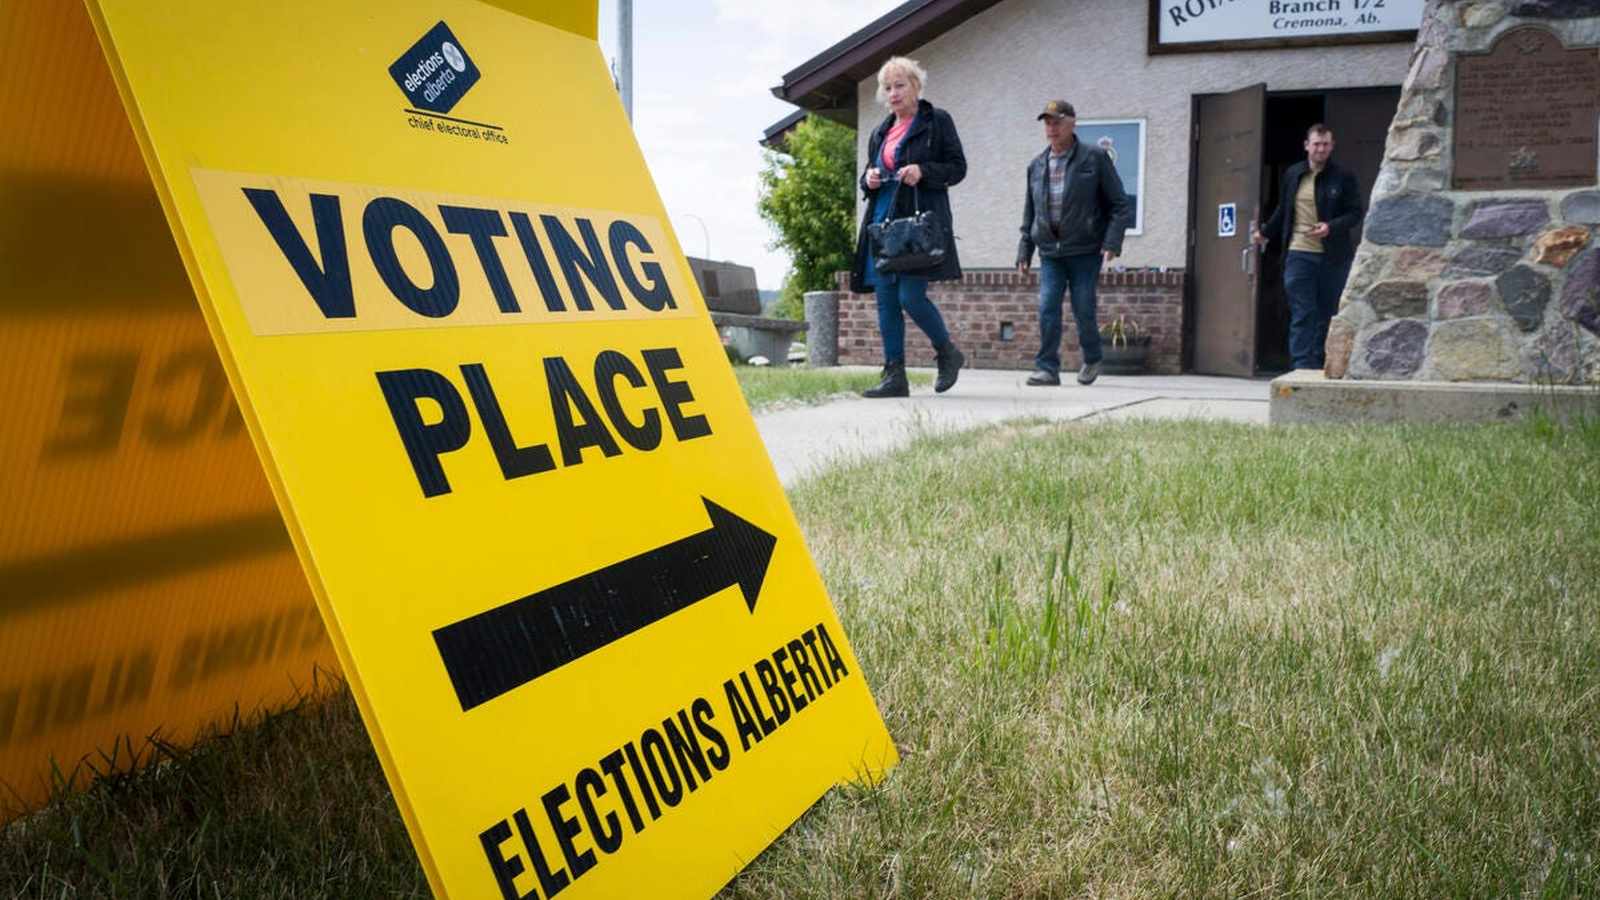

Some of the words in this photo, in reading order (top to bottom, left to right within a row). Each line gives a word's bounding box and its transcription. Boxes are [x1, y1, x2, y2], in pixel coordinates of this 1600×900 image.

[1269, 0, 1340, 14] Branch
[1273, 16, 1348, 29] Cremona,
[1355, 12, 1381, 24] Ab.
[404, 51, 444, 92] elections
[423, 68, 456, 103] alberta
[408, 115, 433, 132] chief
[436, 121, 480, 140] electoral
[482, 129, 509, 144] office
[241, 187, 677, 319] VOTING
[375, 347, 713, 499] PLACE
[478, 697, 731, 900] ELECTIONS
[723, 622, 849, 753] ALBERTA
